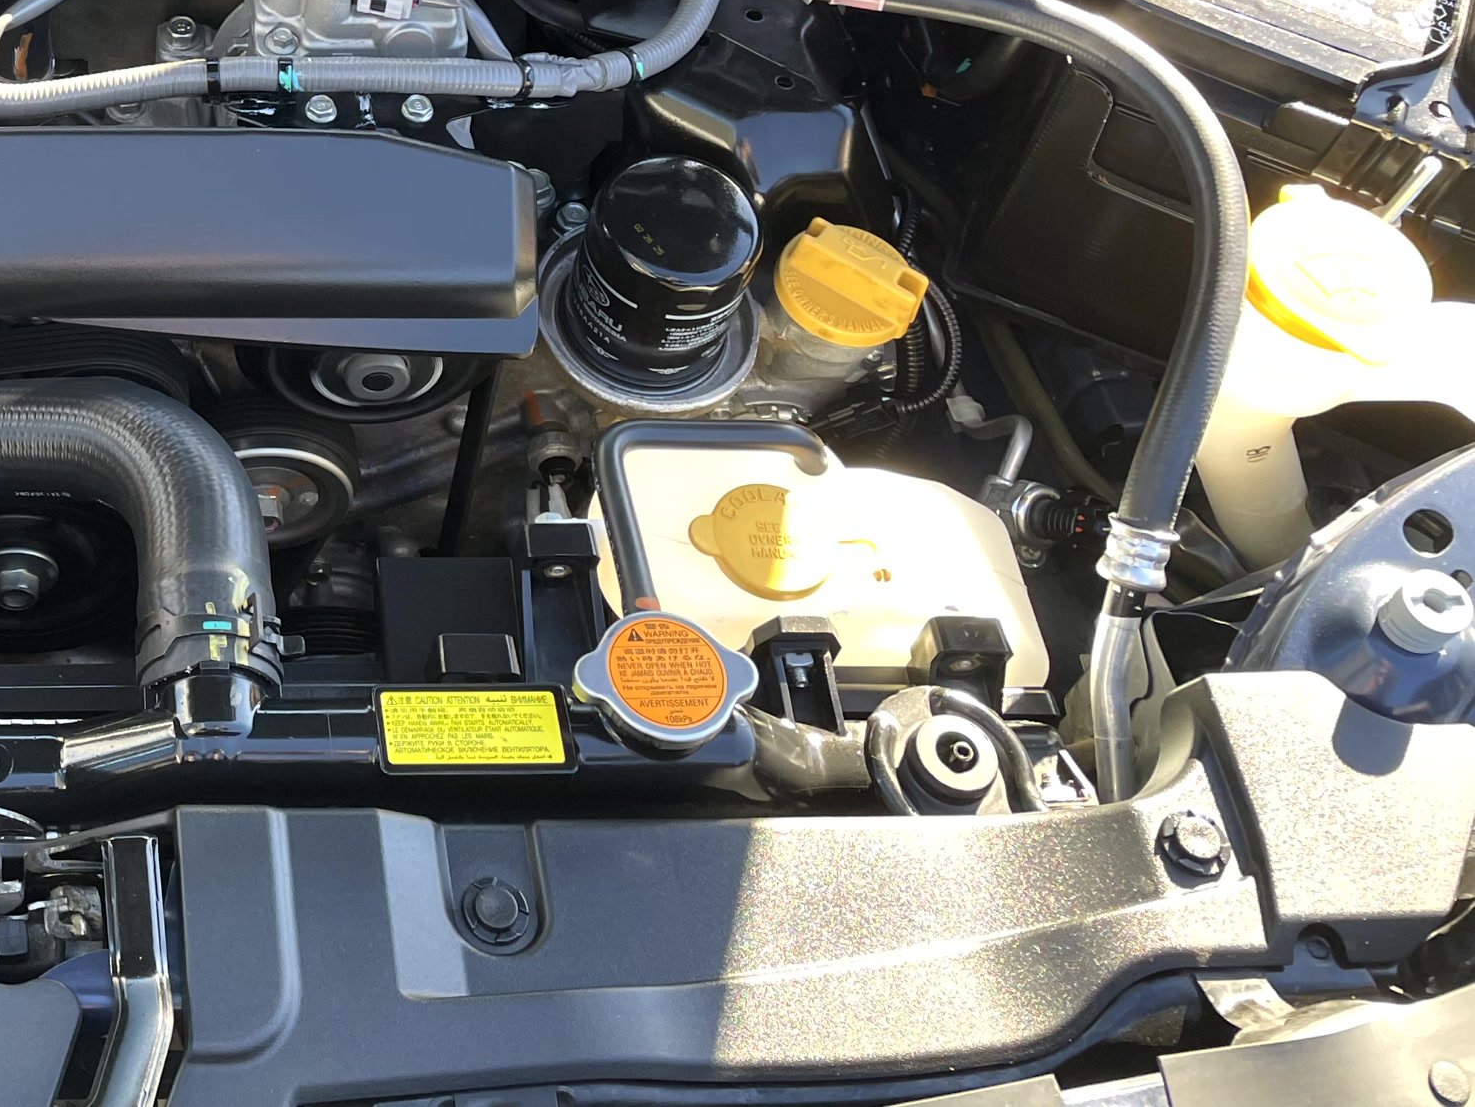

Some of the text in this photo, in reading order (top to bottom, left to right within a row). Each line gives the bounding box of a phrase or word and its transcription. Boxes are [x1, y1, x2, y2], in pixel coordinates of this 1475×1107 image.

[783, 268, 885, 333] SEE OWNER'S MANUAL
[721, 487, 786, 520] COOLA
[755, 521, 781, 533] SEE
[415, 696, 442, 704] CAUTION
[446, 696, 480, 704] ATTENTION
[639, 699, 709, 708] AVERTISSEMENT
[665, 715, 692, 723] 108kPa
